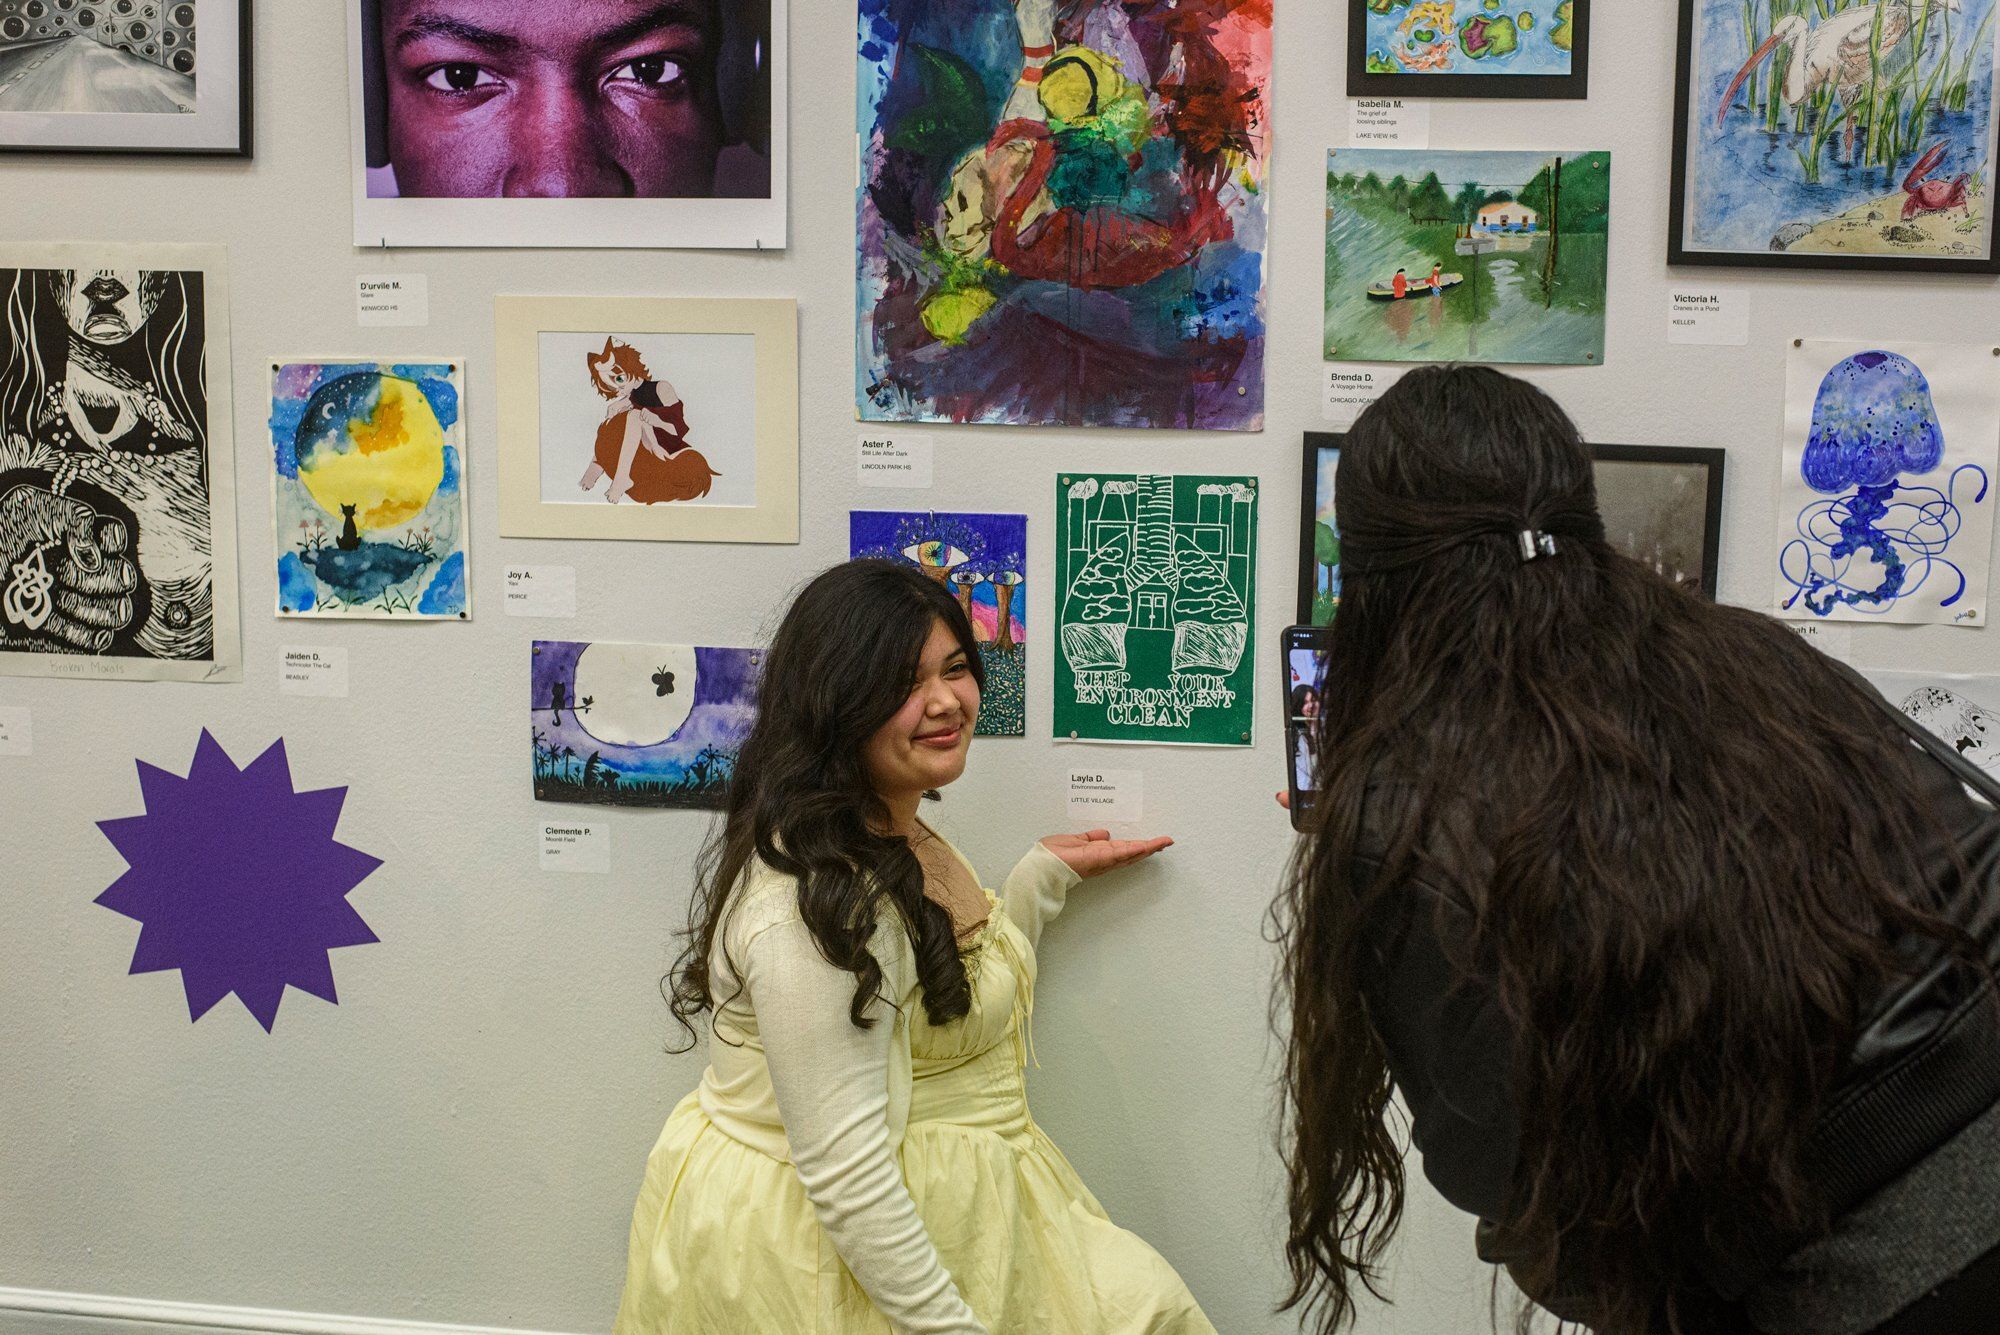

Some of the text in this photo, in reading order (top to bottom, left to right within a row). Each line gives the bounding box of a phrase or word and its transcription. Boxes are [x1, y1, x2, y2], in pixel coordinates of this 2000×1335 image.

[1357, 100, 1391, 108] Isabella
[1674, 294, 1720, 304] Victoria H.
[1332, 373, 1374, 382] Brenda D.
[862, 440, 894, 448] Aster P.
[508, 571, 522, 580] Joy
[1809, 626, 1818, 634] H.
[285, 652, 321, 661] Jaiden D.
[1074, 671, 1227, 693] KEEP YOUR
[1075, 687, 1236, 709] ENVIRONMENT
[1106, 704, 1194, 729] CLEAN
[1071, 774, 1094, 784] Layla
[545, 827, 582, 836] Clemente
